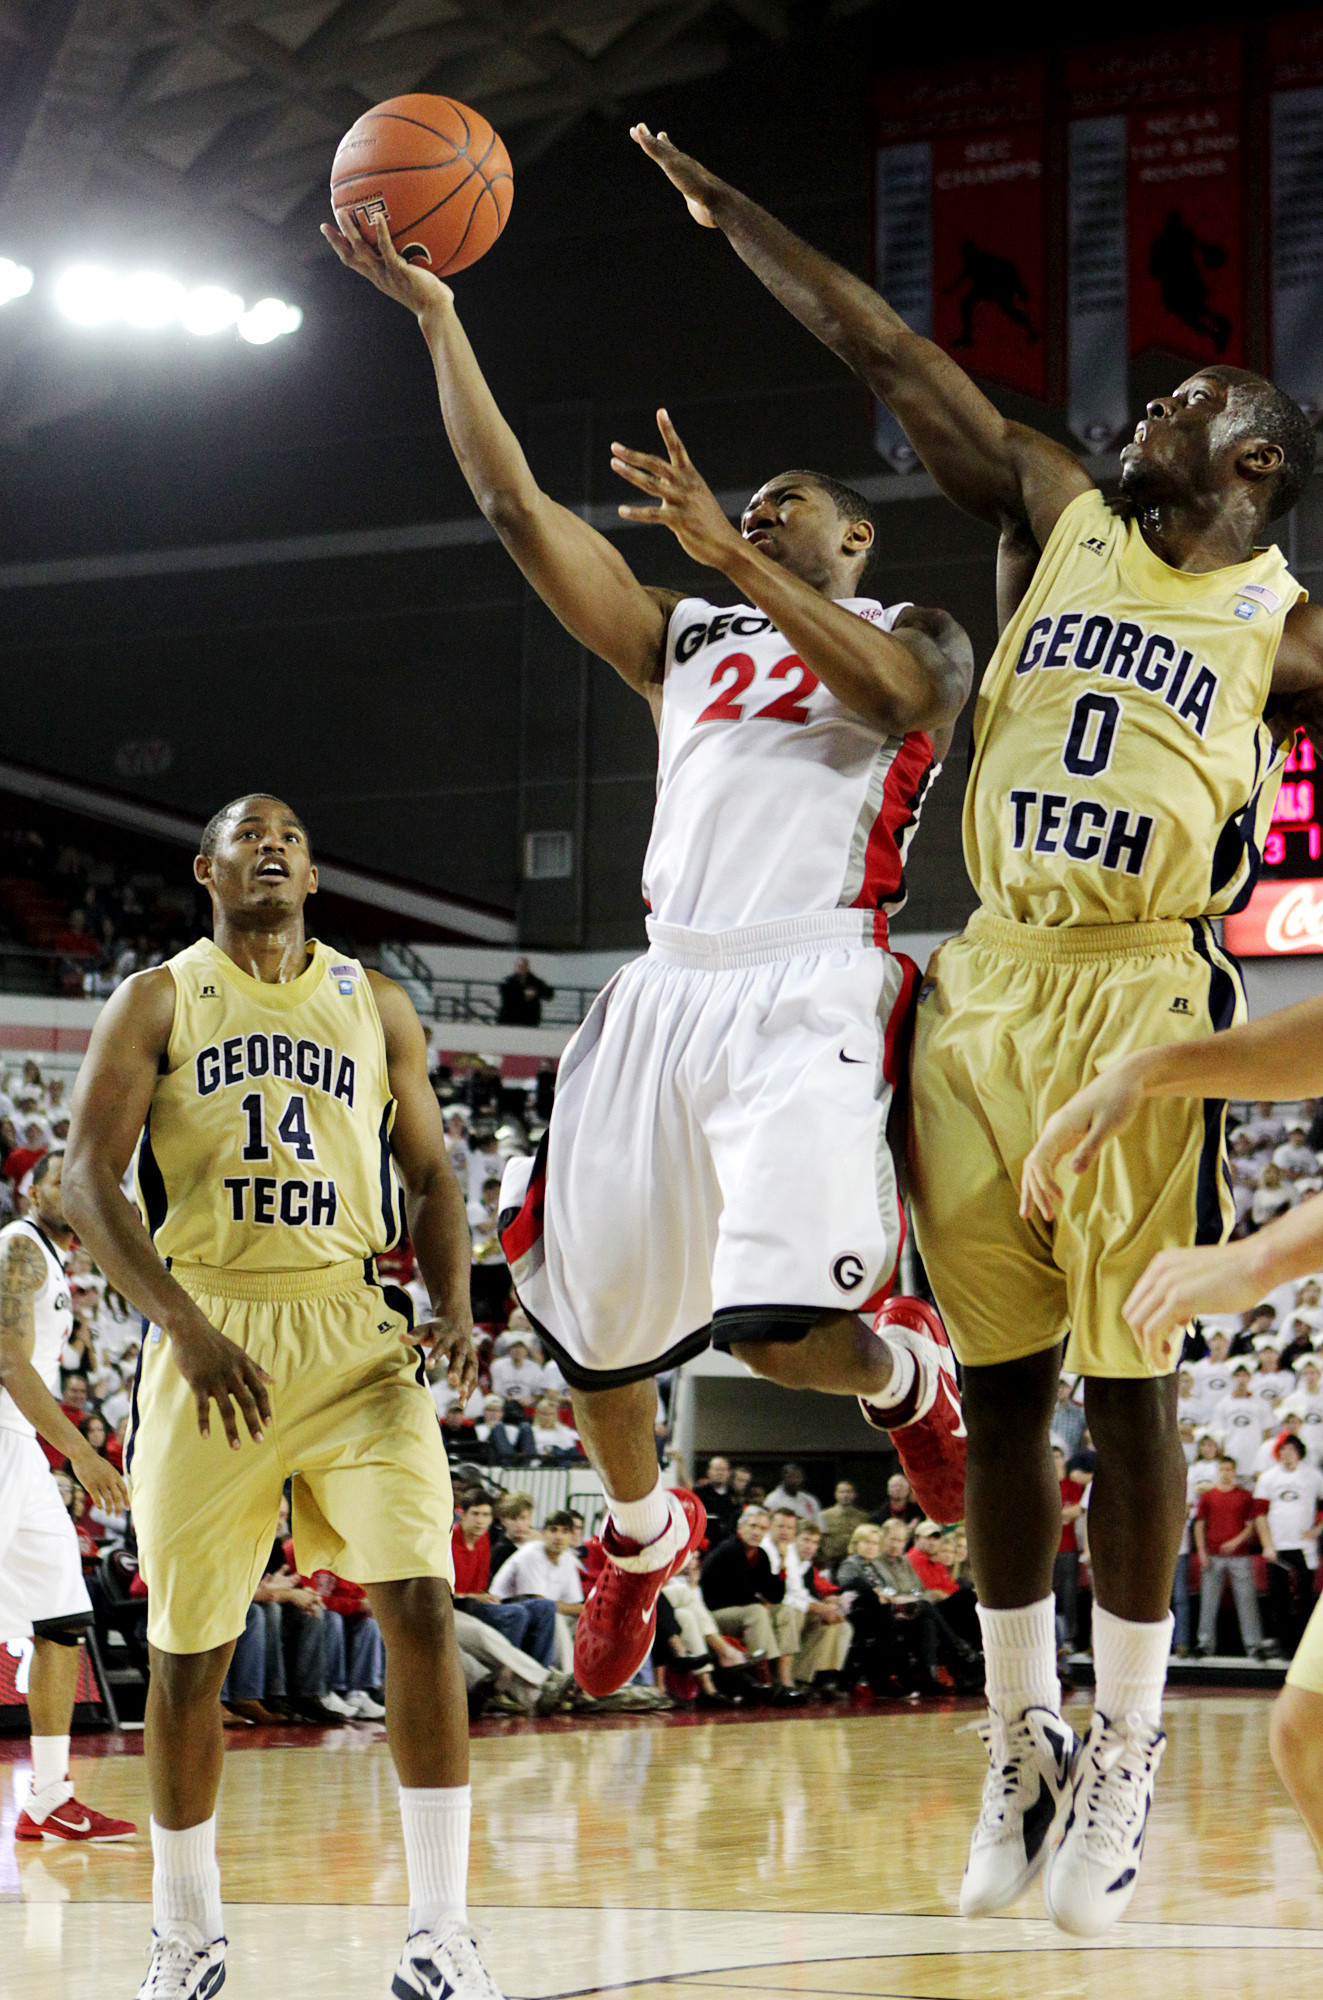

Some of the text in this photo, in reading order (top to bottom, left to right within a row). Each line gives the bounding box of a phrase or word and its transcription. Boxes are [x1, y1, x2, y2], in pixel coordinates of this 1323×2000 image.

[675, 612, 779, 664] GEO
[693, 652, 820, 726] 22
[1014, 612, 1221, 740] GEORGIA
[1061, 689, 1123, 777] 0
[1010, 789, 1156, 878] TECH
[196, 1033, 356, 1112] GEORGIA
[241, 1091, 316, 1163] 14
[224, 1177, 337, 1227] TECH
[832, 1254, 865, 1291] G
